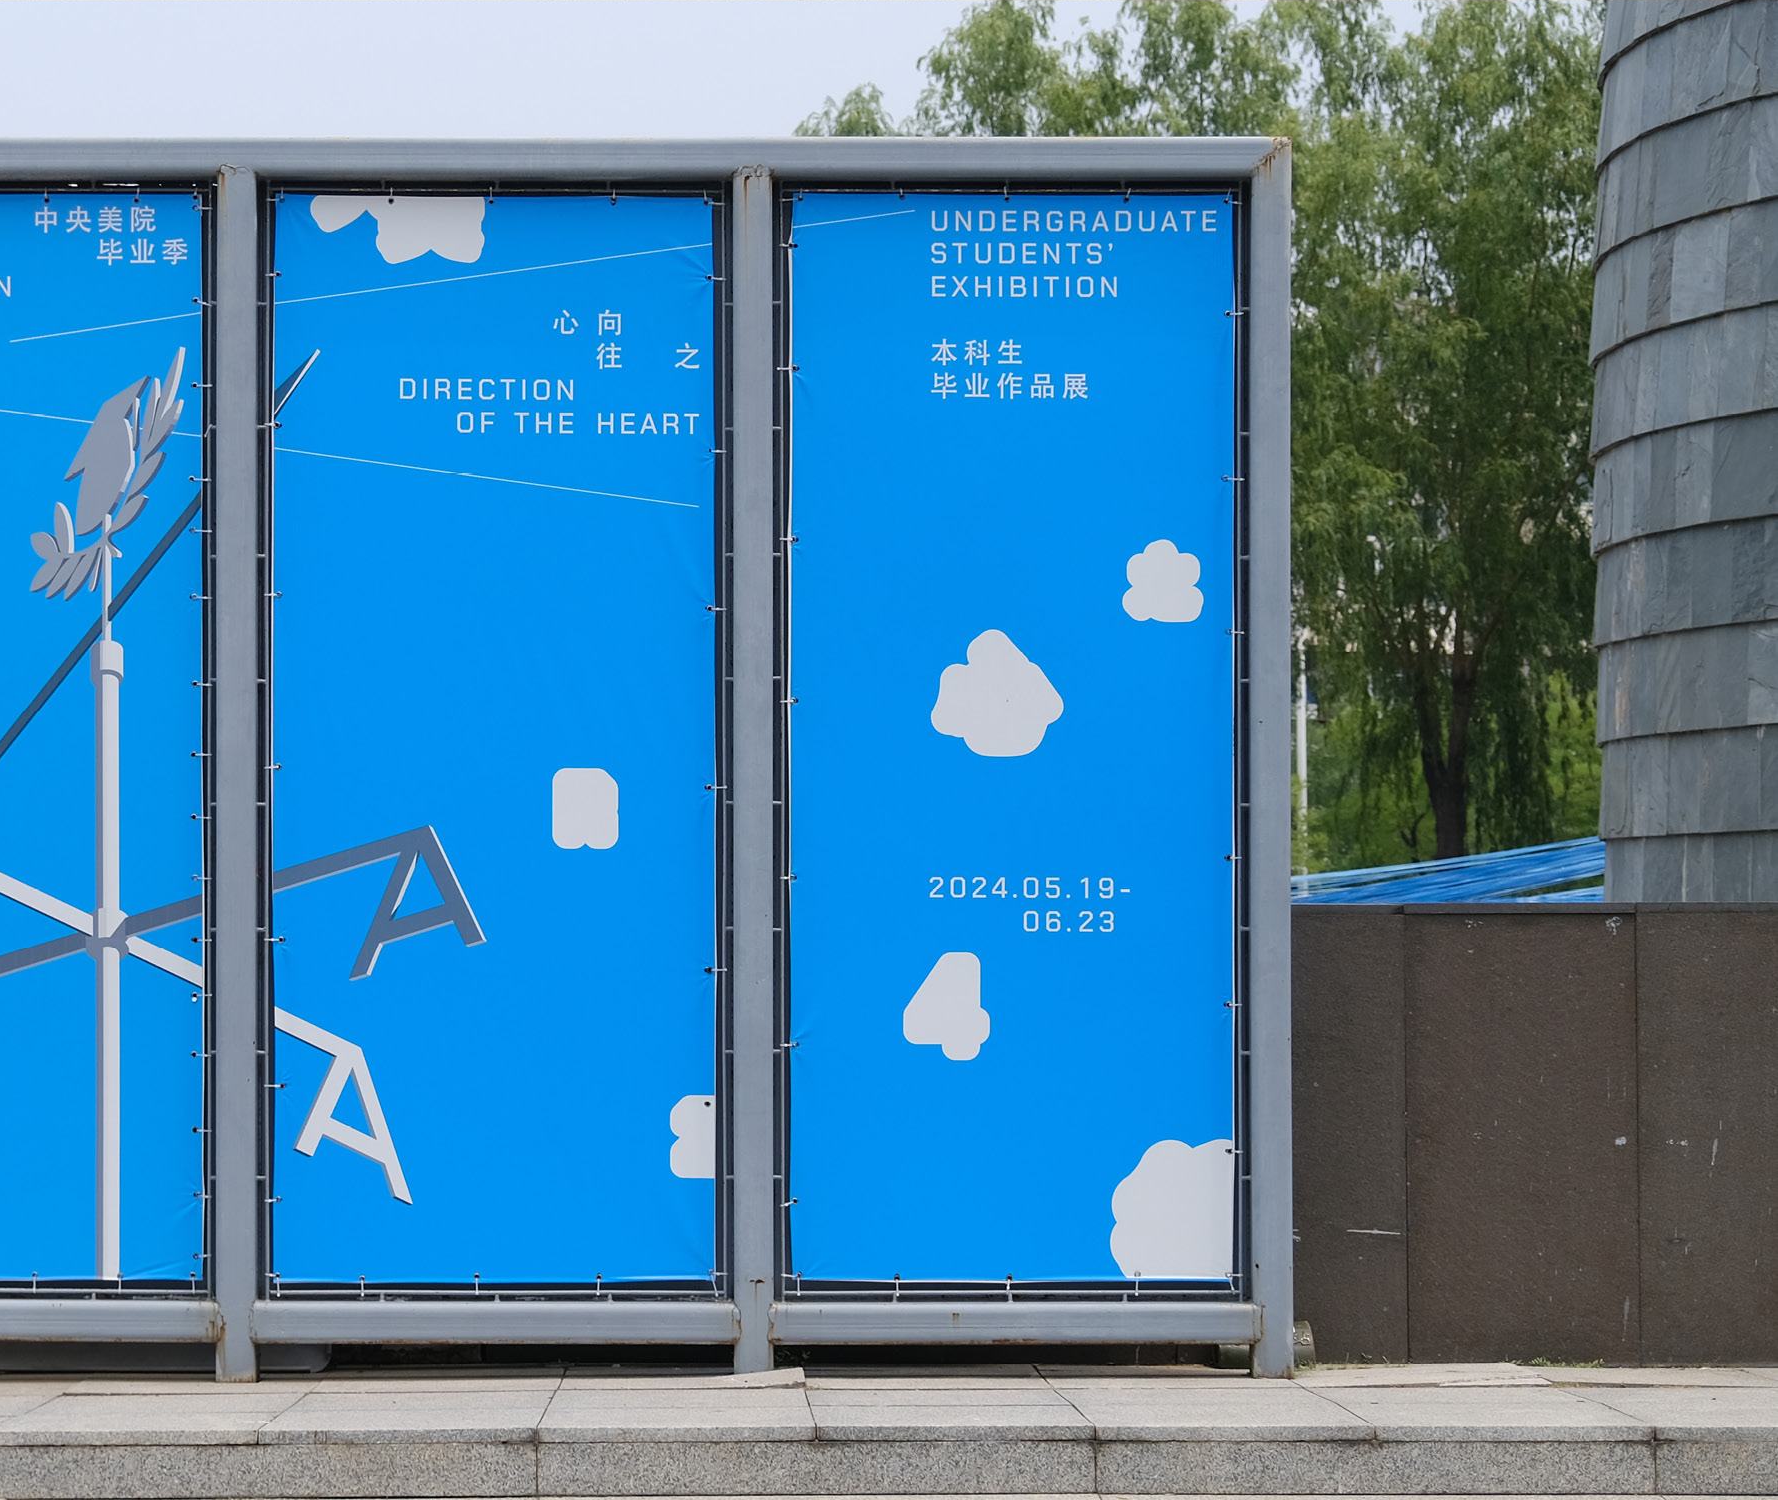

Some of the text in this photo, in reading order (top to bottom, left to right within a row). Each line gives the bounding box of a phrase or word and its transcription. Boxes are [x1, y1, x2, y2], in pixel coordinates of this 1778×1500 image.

[34, 206, 157, 234] 中央美院
[931, 210, 1217, 232] UNDERGRADUATE
[96, 238, 189, 266] 毕业季
[931, 276, 1118, 297] EXHIBITION
[931, 338, 1023, 366] 本科生
[399, 378, 575, 401] DIRECTION
[931, 372, 1089, 399] 毕业作品展
[456, 412, 700, 435] OF THE HEART
[929, 877, 1131, 899] 2024.05.19-
[1023, 910, 1115, 933] 06.23
